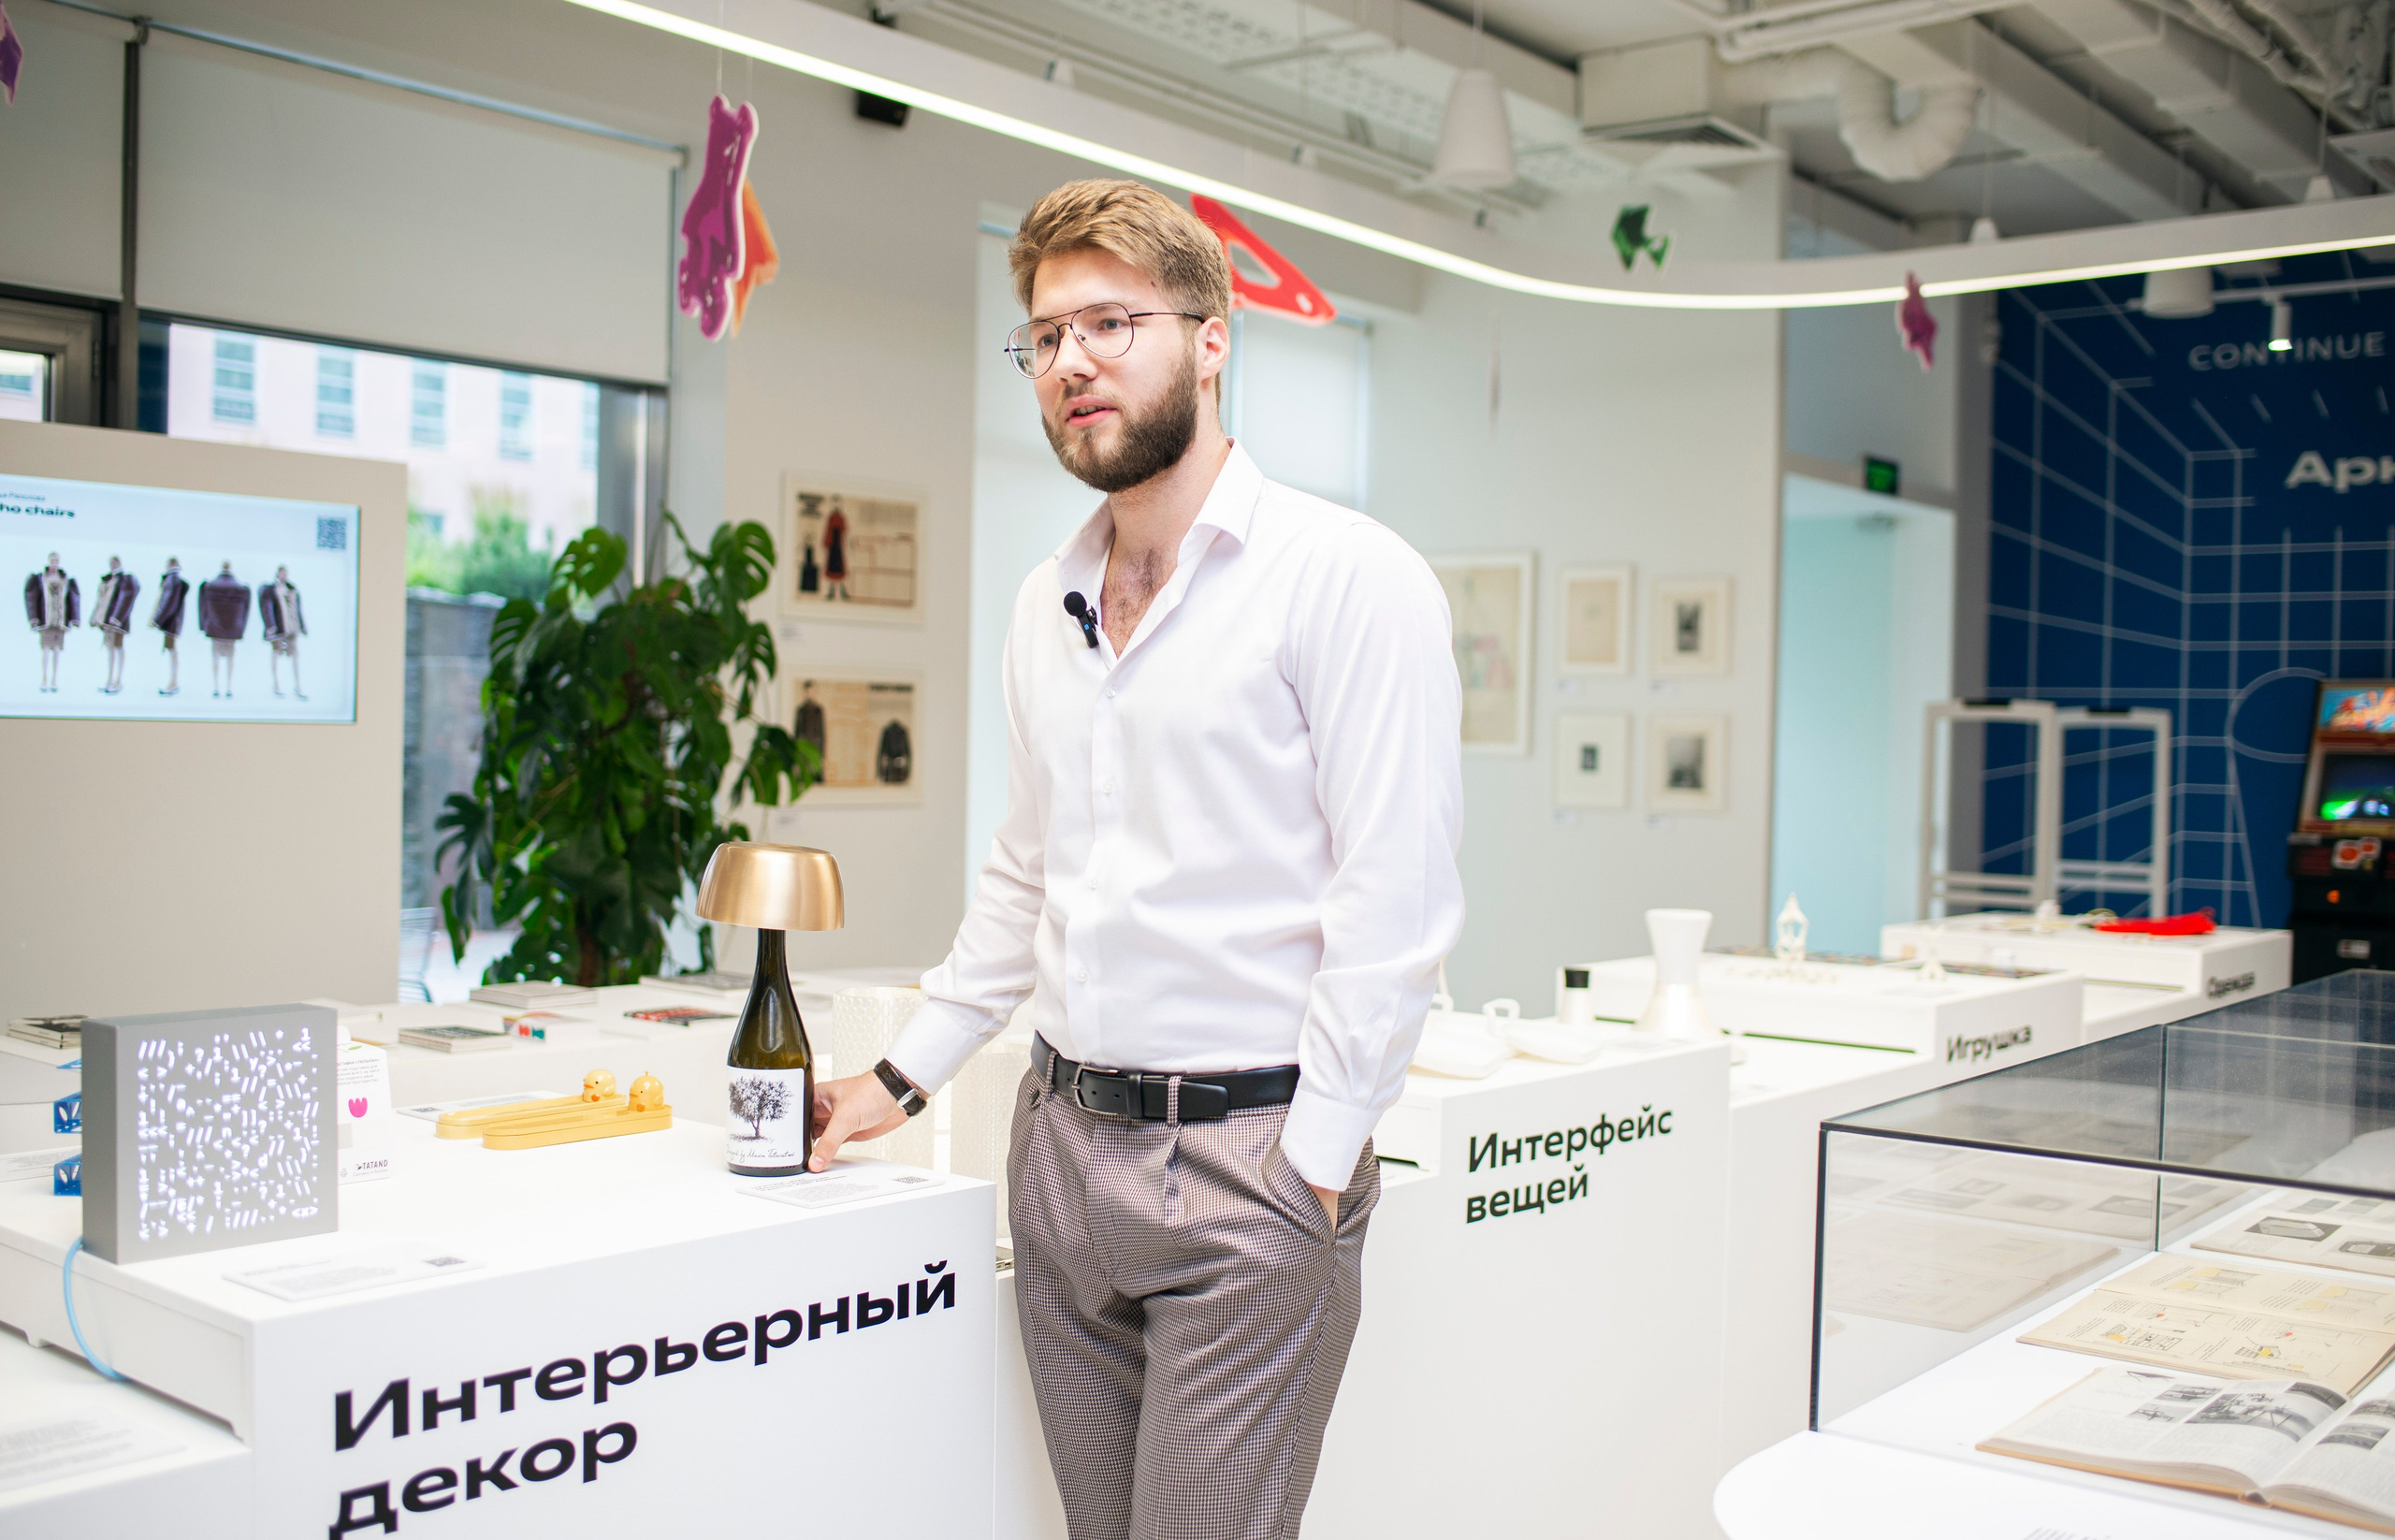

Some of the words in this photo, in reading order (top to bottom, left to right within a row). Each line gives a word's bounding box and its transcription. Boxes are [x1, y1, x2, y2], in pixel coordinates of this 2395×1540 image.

[24, 505, 75, 518] chairs
[1947, 1024, 2031, 1063] Игрушка
[362, 1159, 388, 1170] TATAND
[1469, 1104, 1673, 1173] Интерфейс
[1466, 1163, 1589, 1224] вещей
[334, 1259, 956, 1452] Интерьерный
[328, 1420, 638, 1540] декор
